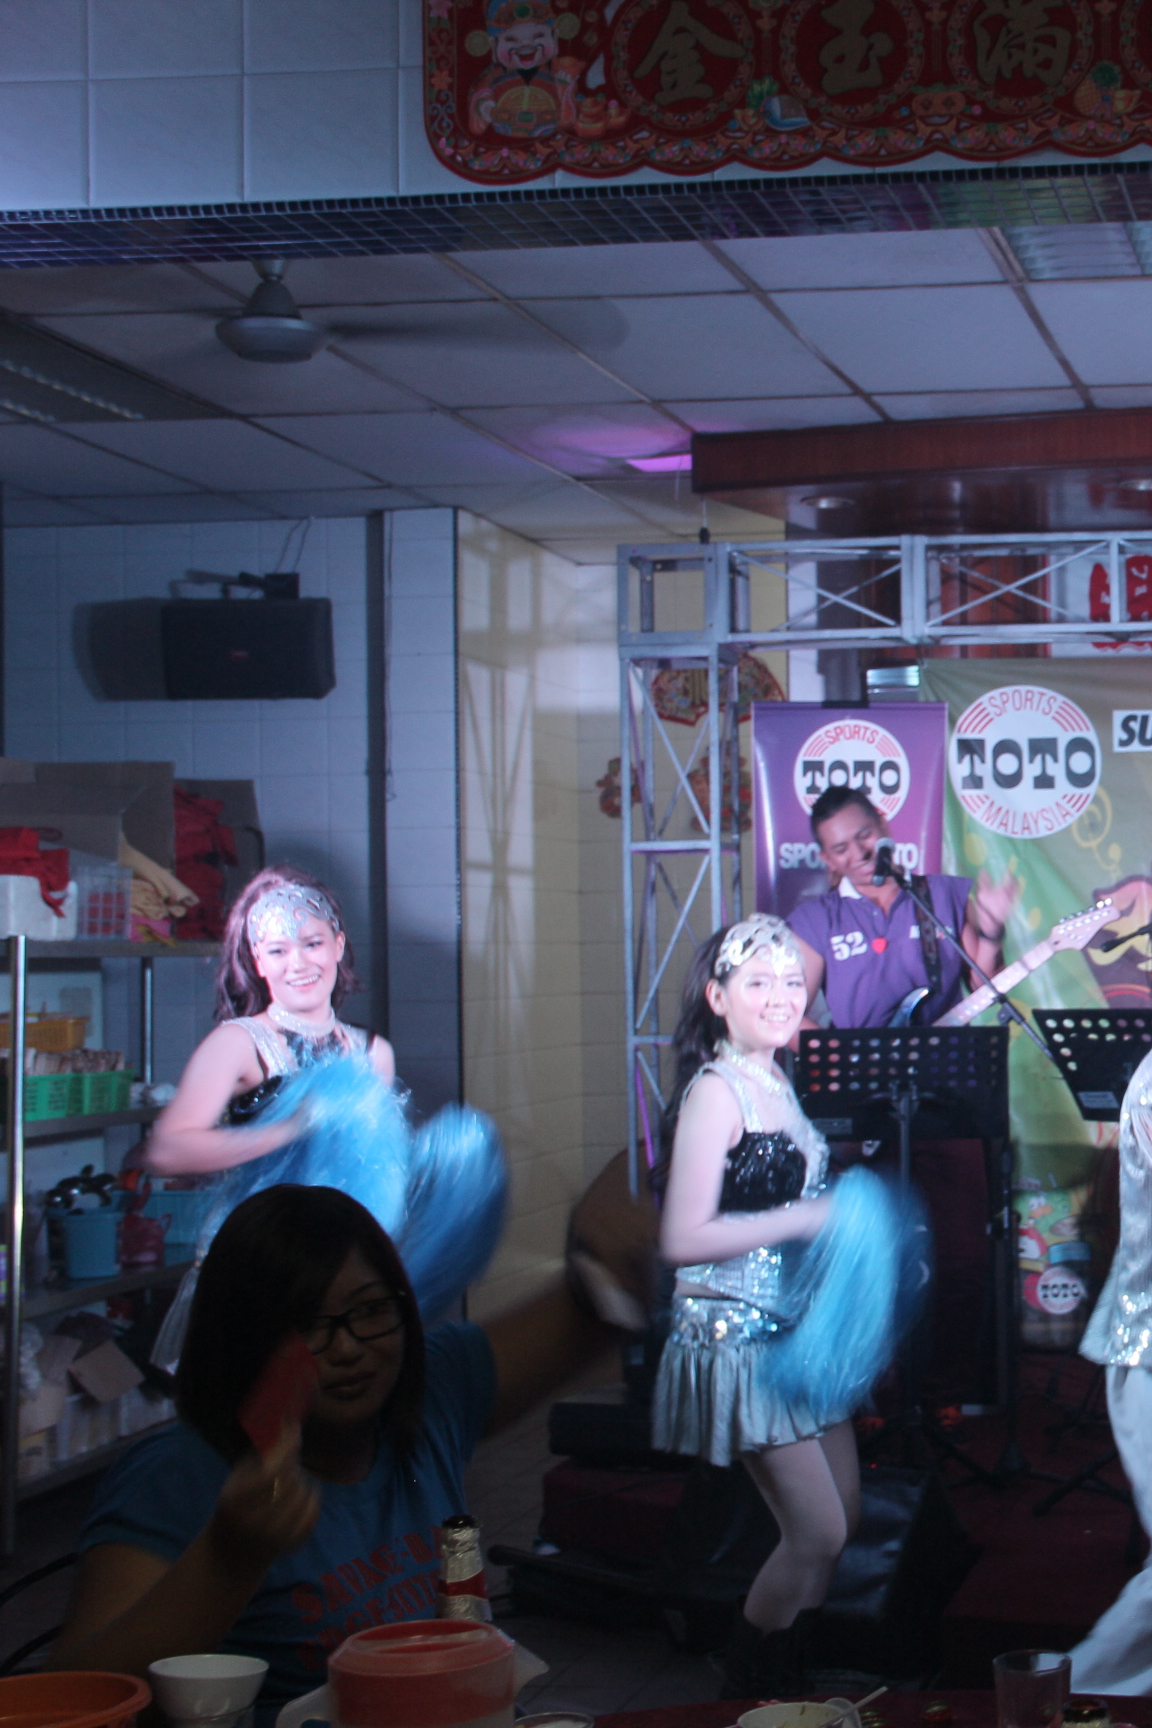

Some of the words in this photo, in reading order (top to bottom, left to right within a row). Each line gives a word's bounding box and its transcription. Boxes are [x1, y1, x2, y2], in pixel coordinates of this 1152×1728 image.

[988, 689, 1057, 717] SPORTS
[824, 724, 879, 745] SPORTS
[802, 760, 901, 795] TOTO
[957, 736, 1096, 790] TOTO
[980, 801, 1075, 836] MALAYSIA
[779, 842, 826, 869] SPO
[830, 931, 868, 960] 52
